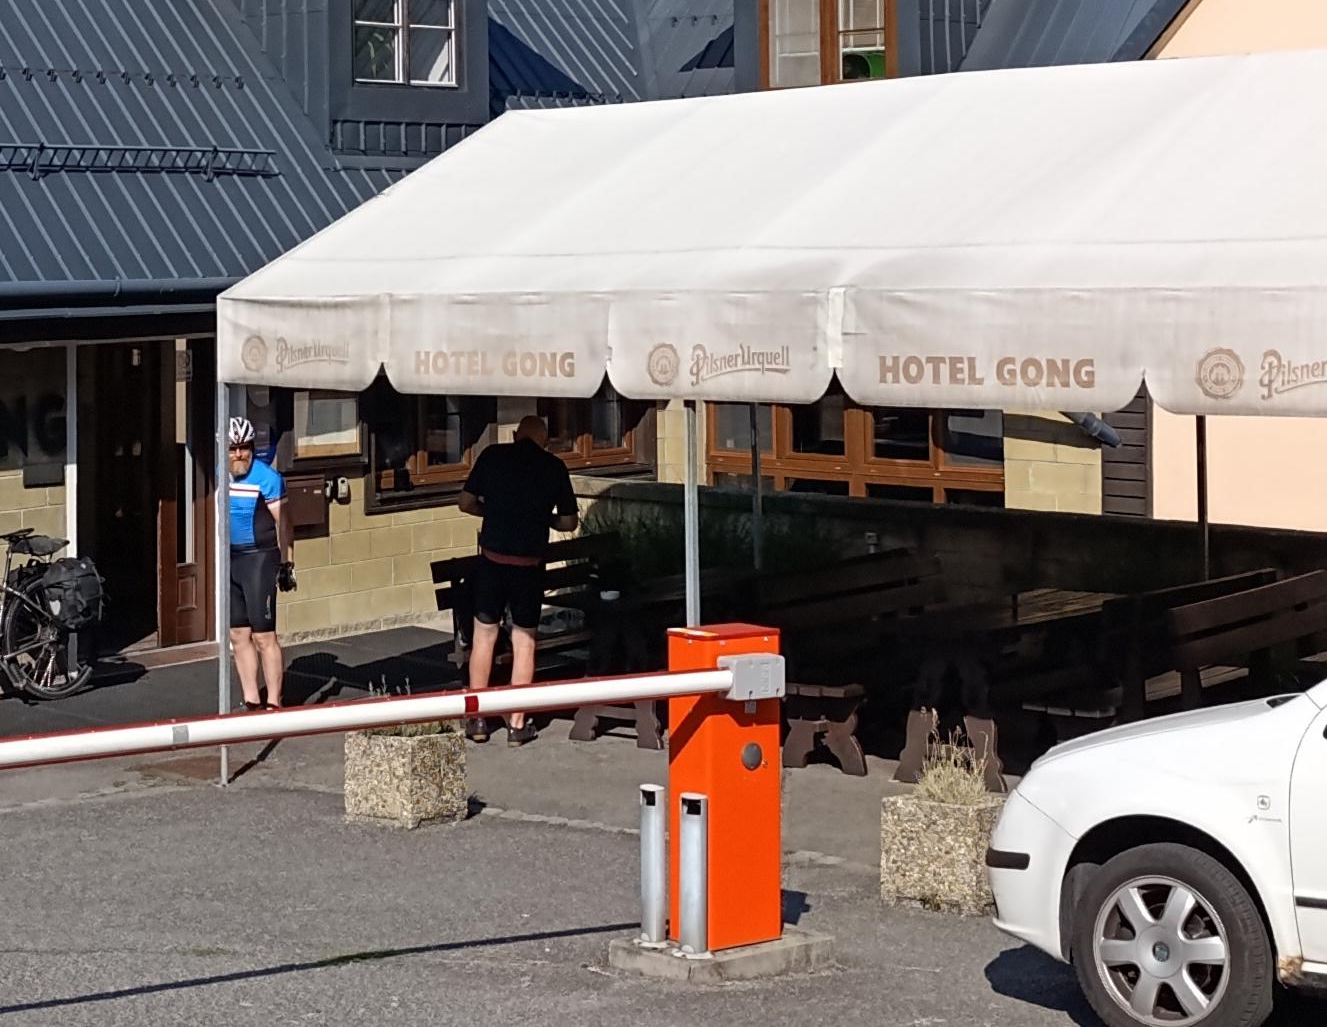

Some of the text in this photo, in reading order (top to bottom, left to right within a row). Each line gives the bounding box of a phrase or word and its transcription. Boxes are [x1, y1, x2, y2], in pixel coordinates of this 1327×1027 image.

[415, 350, 576, 377] HOTEL GONG
[690, 344, 791, 386] Pilsner Urquell
[878, 355, 1096, 389] HOTEL GONG
